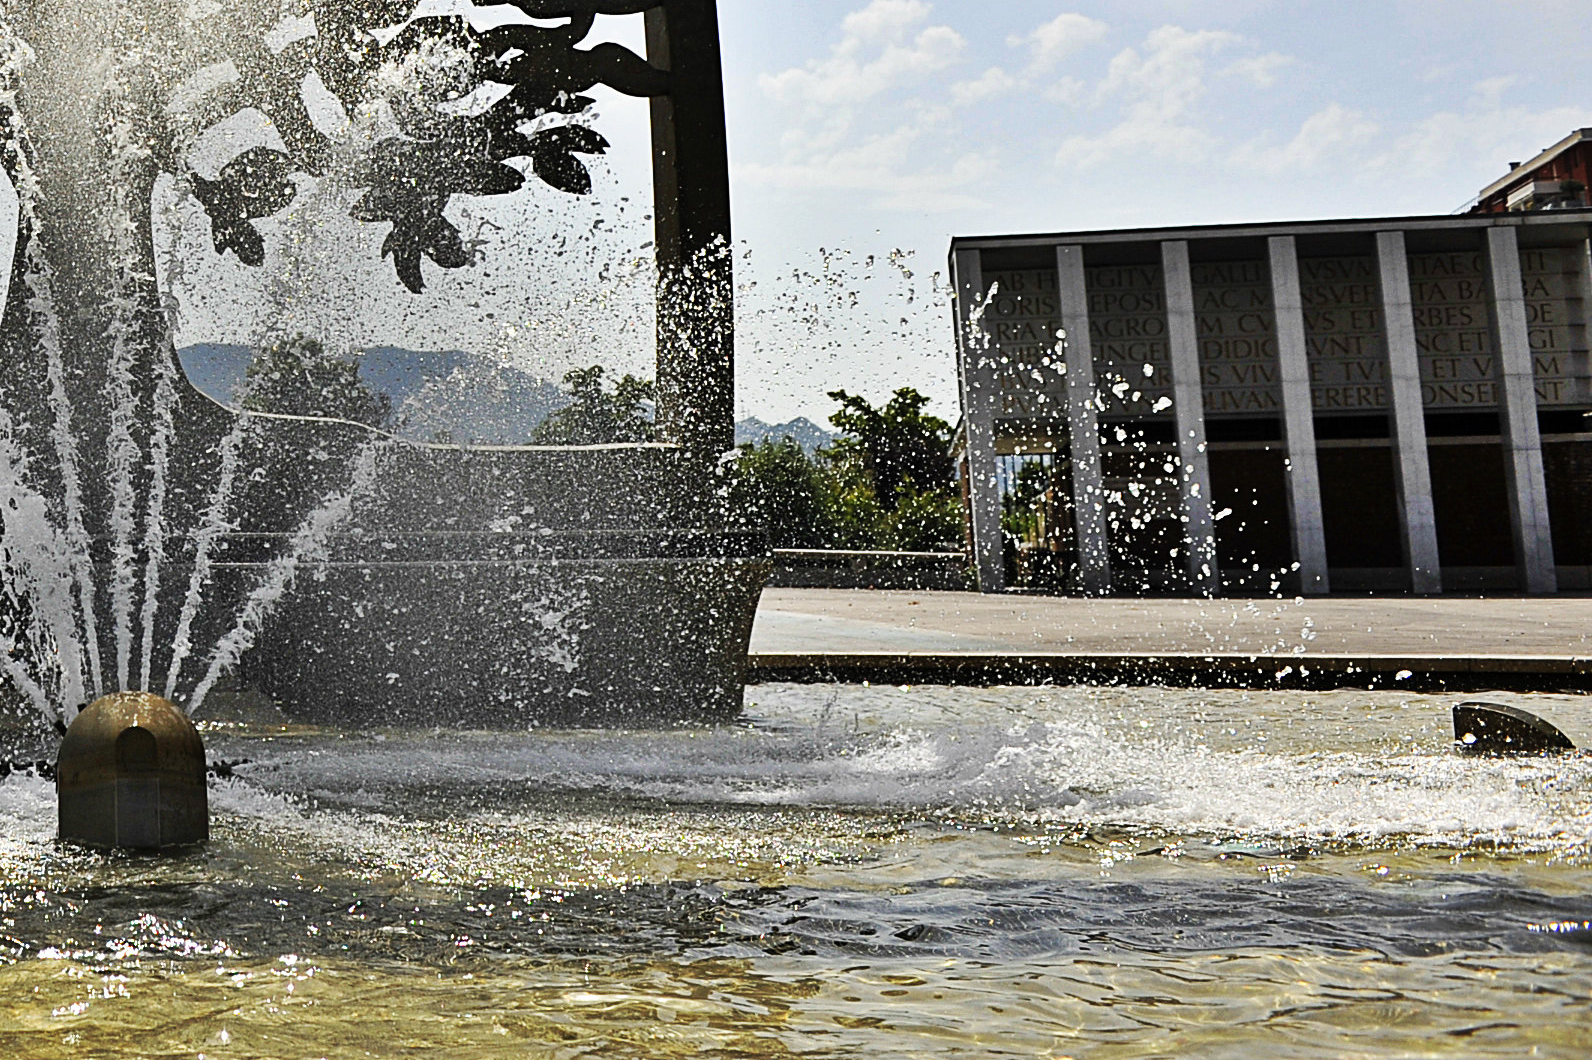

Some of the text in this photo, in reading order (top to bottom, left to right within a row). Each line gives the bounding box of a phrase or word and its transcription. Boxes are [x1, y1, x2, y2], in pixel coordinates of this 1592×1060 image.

[1191, 264, 1261, 286] GALLI
[1409, 254, 1464, 277] ITAE
[1202, 290, 1238, 310] AC
[1413, 304, 1473, 328] RBES
[1310, 385, 1387, 409] ERERE
